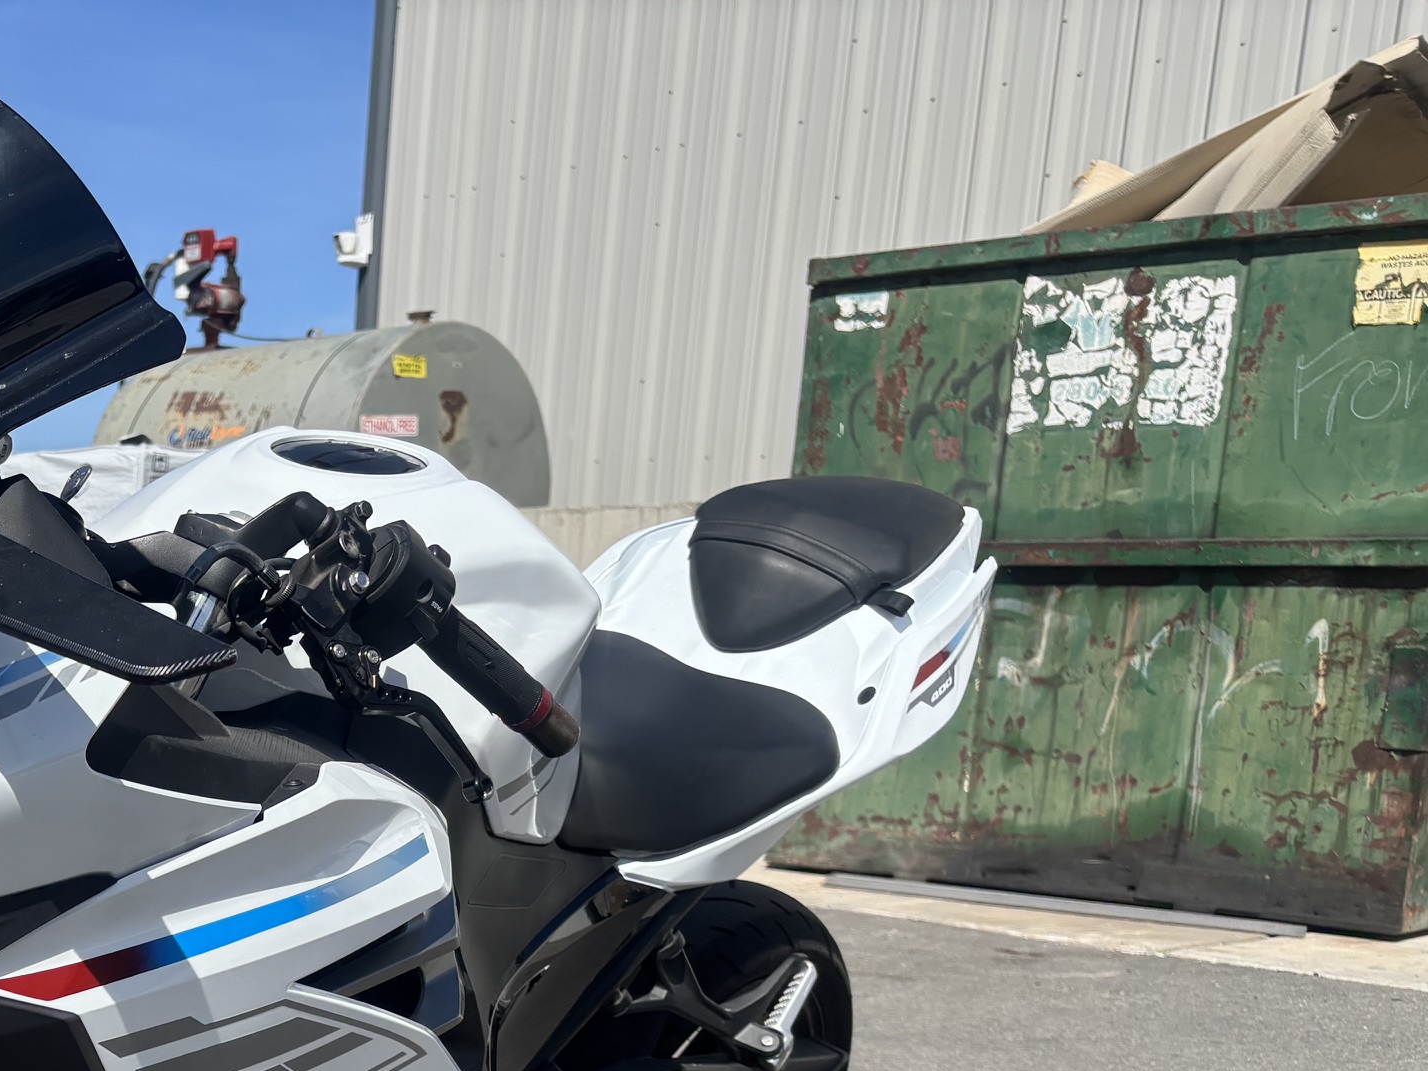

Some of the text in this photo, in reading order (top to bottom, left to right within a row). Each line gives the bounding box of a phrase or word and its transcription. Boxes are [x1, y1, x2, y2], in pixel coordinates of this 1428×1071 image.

[362, 420, 416, 432] ETHANOL FREE
[930, 676, 952, 702] 400
